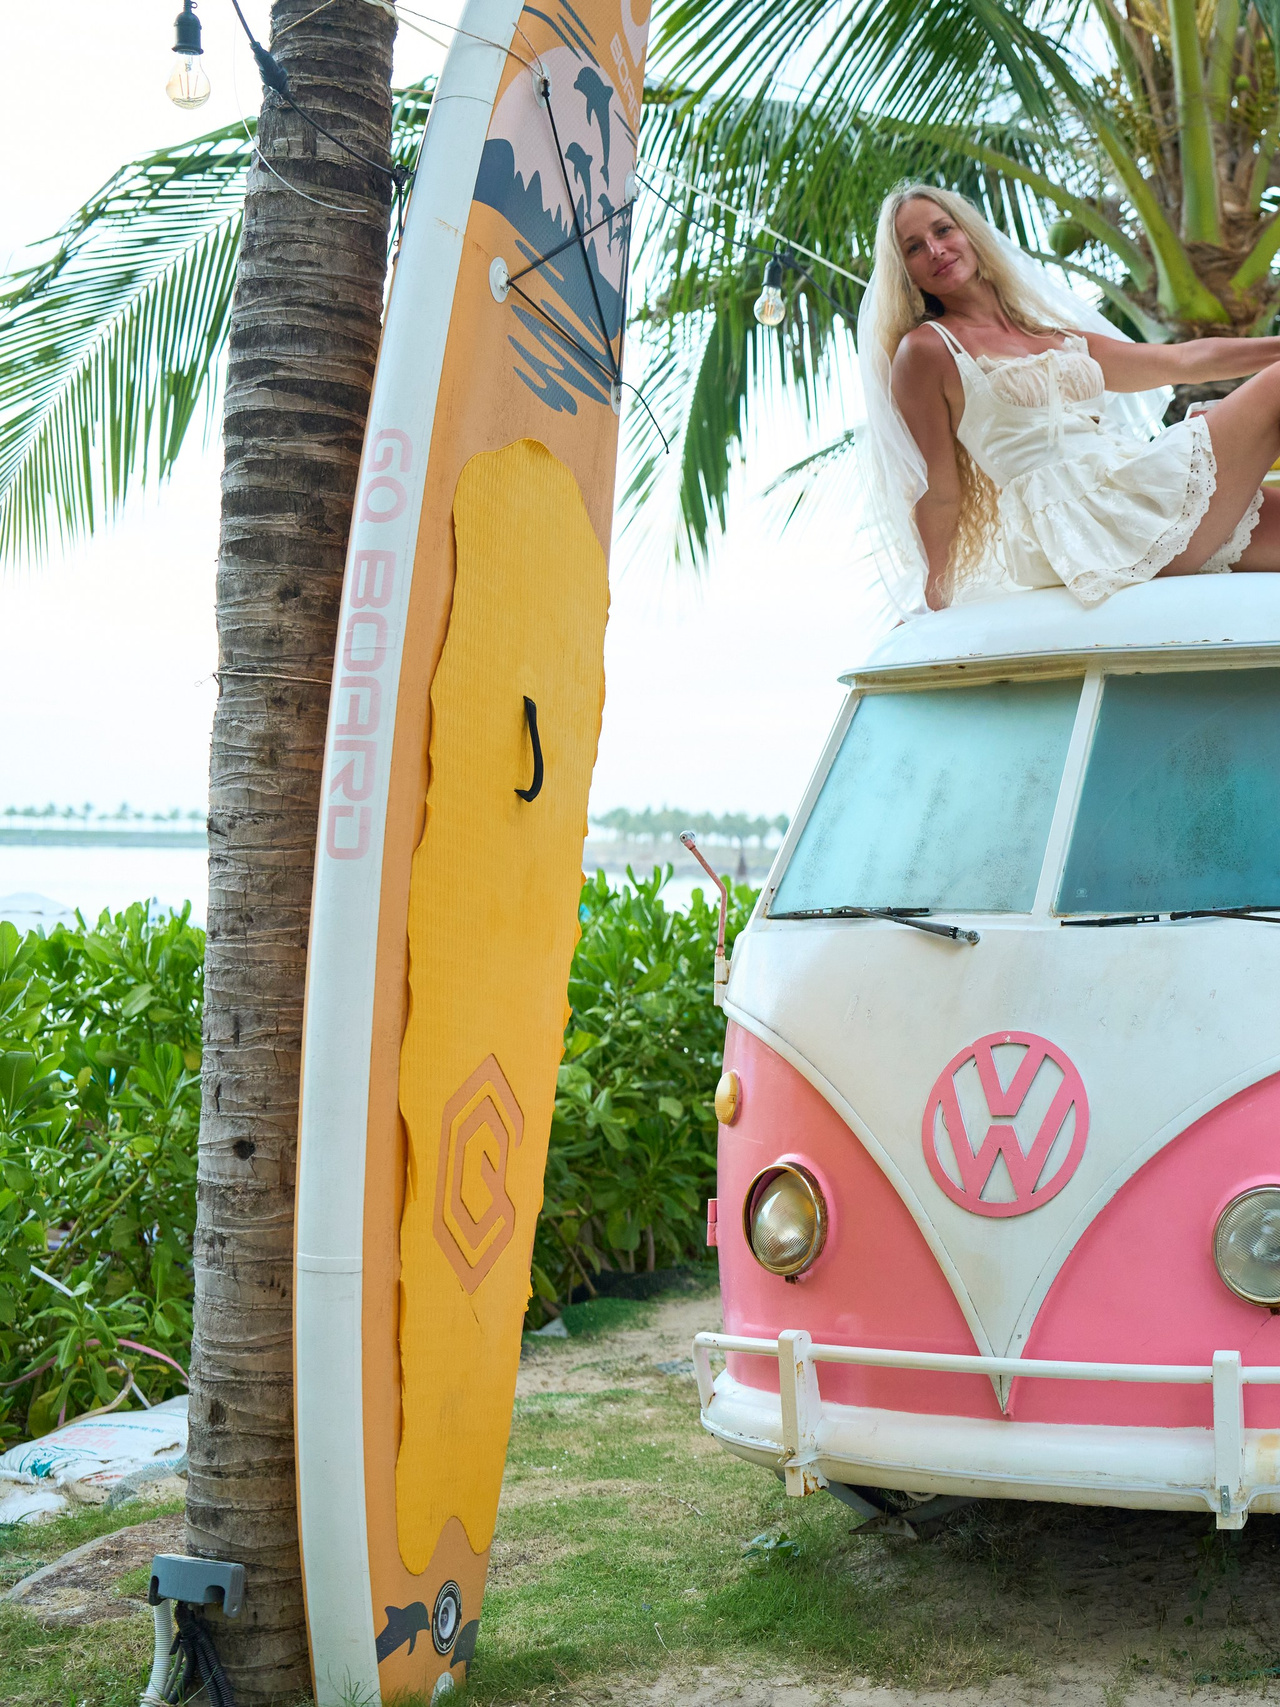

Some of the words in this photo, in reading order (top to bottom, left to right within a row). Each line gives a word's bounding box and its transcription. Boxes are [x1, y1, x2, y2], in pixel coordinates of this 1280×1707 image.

[358, 427, 414, 524] GQ
[326, 549, 397, 861] BOARD
[931, 1036, 1081, 1210] VW
